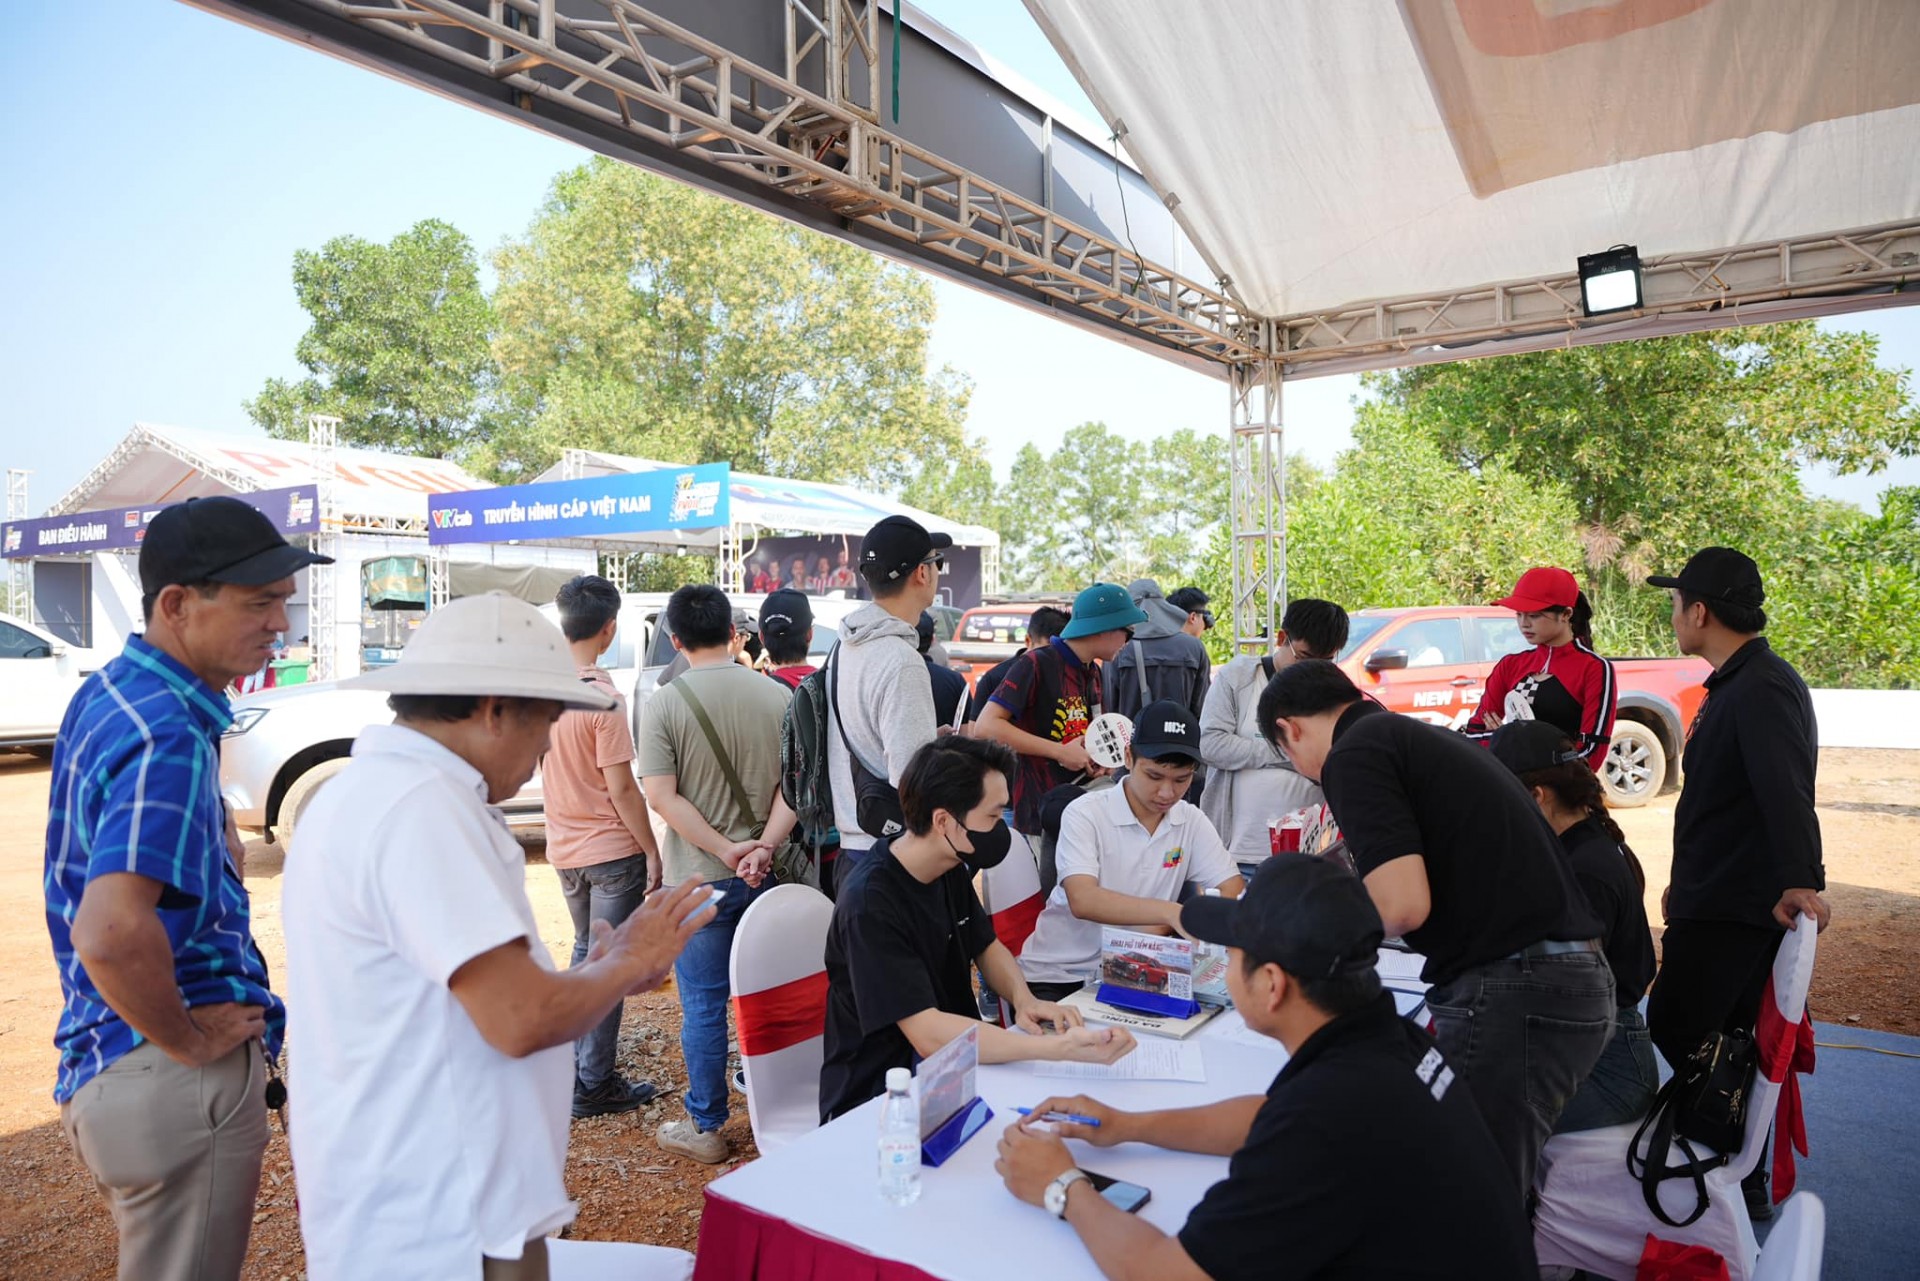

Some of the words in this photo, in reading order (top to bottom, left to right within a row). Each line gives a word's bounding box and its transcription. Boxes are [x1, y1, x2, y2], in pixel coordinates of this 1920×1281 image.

[527, 501, 558, 521] HÌNH
[560, 498, 588, 519] CÁP
[590, 495, 617, 519] VIỆT
[619, 495, 651, 514] NAM
[38, 529, 59, 546] BAN
[80, 522, 107, 541] HÀNH
[1413, 690, 1454, 707] NEW
